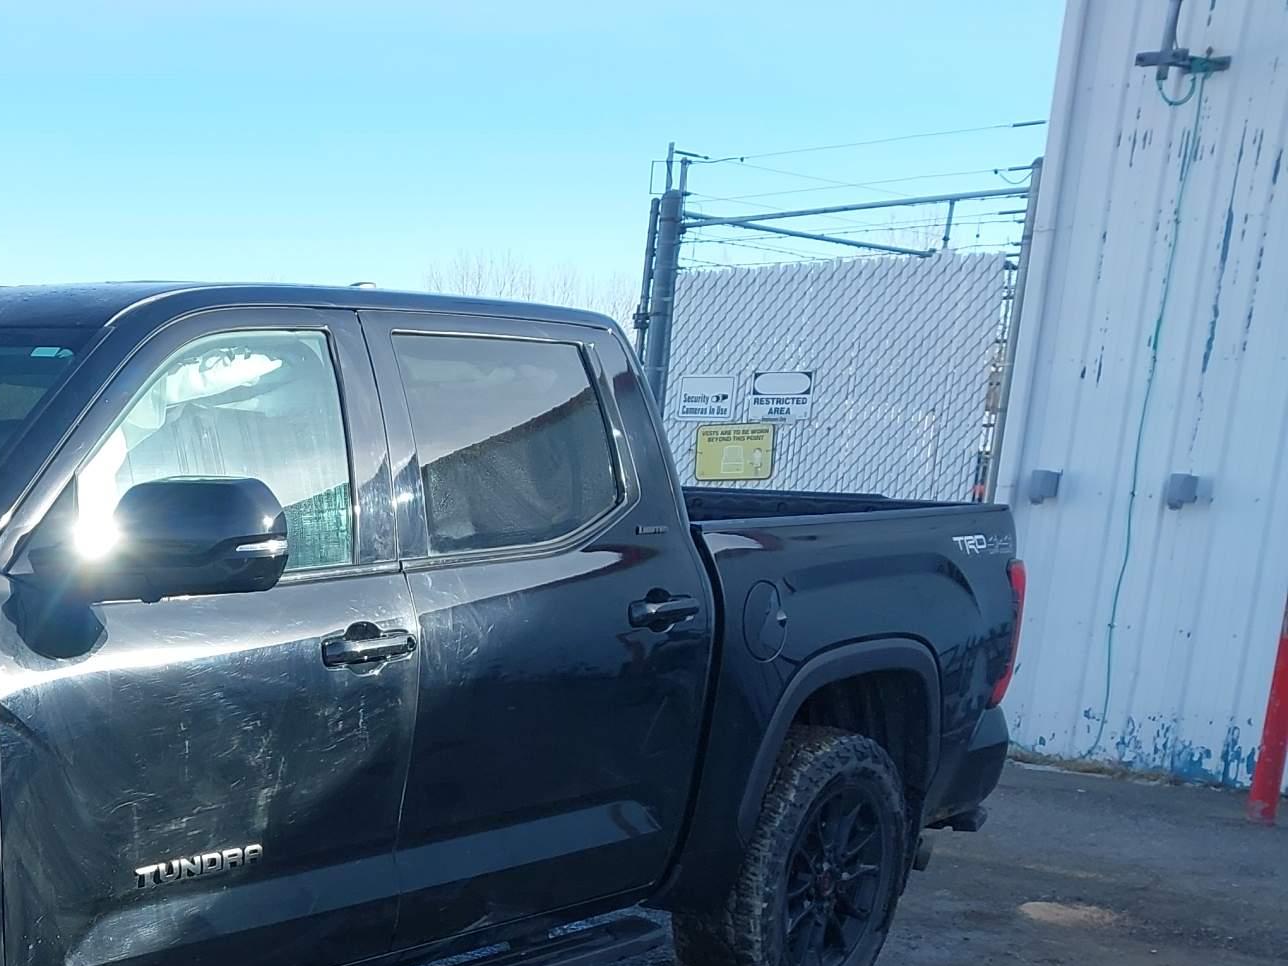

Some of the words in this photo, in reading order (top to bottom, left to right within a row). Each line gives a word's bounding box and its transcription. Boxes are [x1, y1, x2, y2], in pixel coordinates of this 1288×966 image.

[683, 393, 709, 405] Security
[753, 397, 808, 406] RESTRICTED
[681, 405, 708, 415] Cameras
[717, 405, 728, 415] Use
[768, 407, 791, 416] AREA
[952, 534, 987, 555] TRD
[134, 844, 264, 889] TUNDRA
